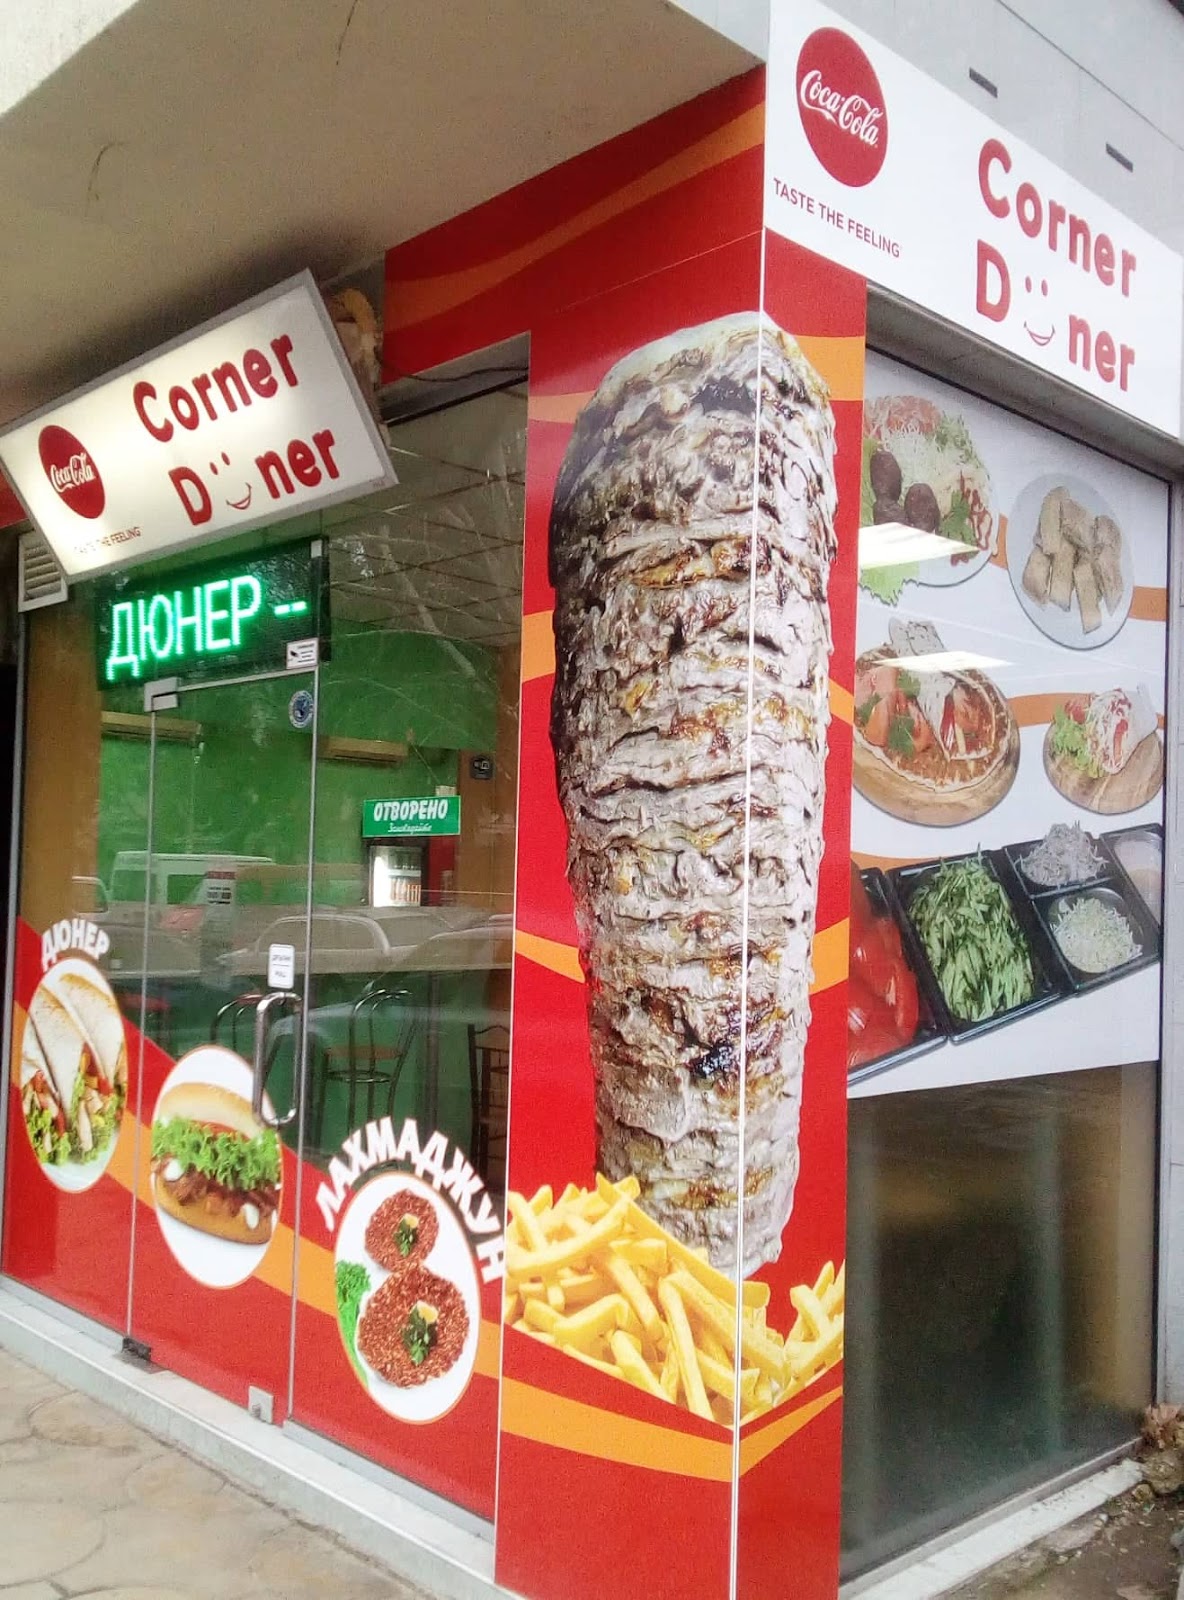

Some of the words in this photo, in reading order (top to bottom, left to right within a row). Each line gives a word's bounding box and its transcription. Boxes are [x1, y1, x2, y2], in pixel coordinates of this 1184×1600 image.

[800, 70, 884, 146] Coca-Cola
[773, 177, 815, 214] TASTE
[818, 202, 844, 229] THE
[847, 218, 900, 258] FEELING
[978, 138, 1136, 297] Corner
[133, 334, 299, 443] Corner
[50, 452, 97, 493] Coca-Cola
[110, 526, 141, 544] FEELING
[106, 575, 262, 681] ДЮНЕР
[373, 799, 449, 822] ОТВОРЕНО
[42, 918, 110, 973] ДЮНЕР
[315, 1116, 504, 1284] ЛАХМАДЖУН
